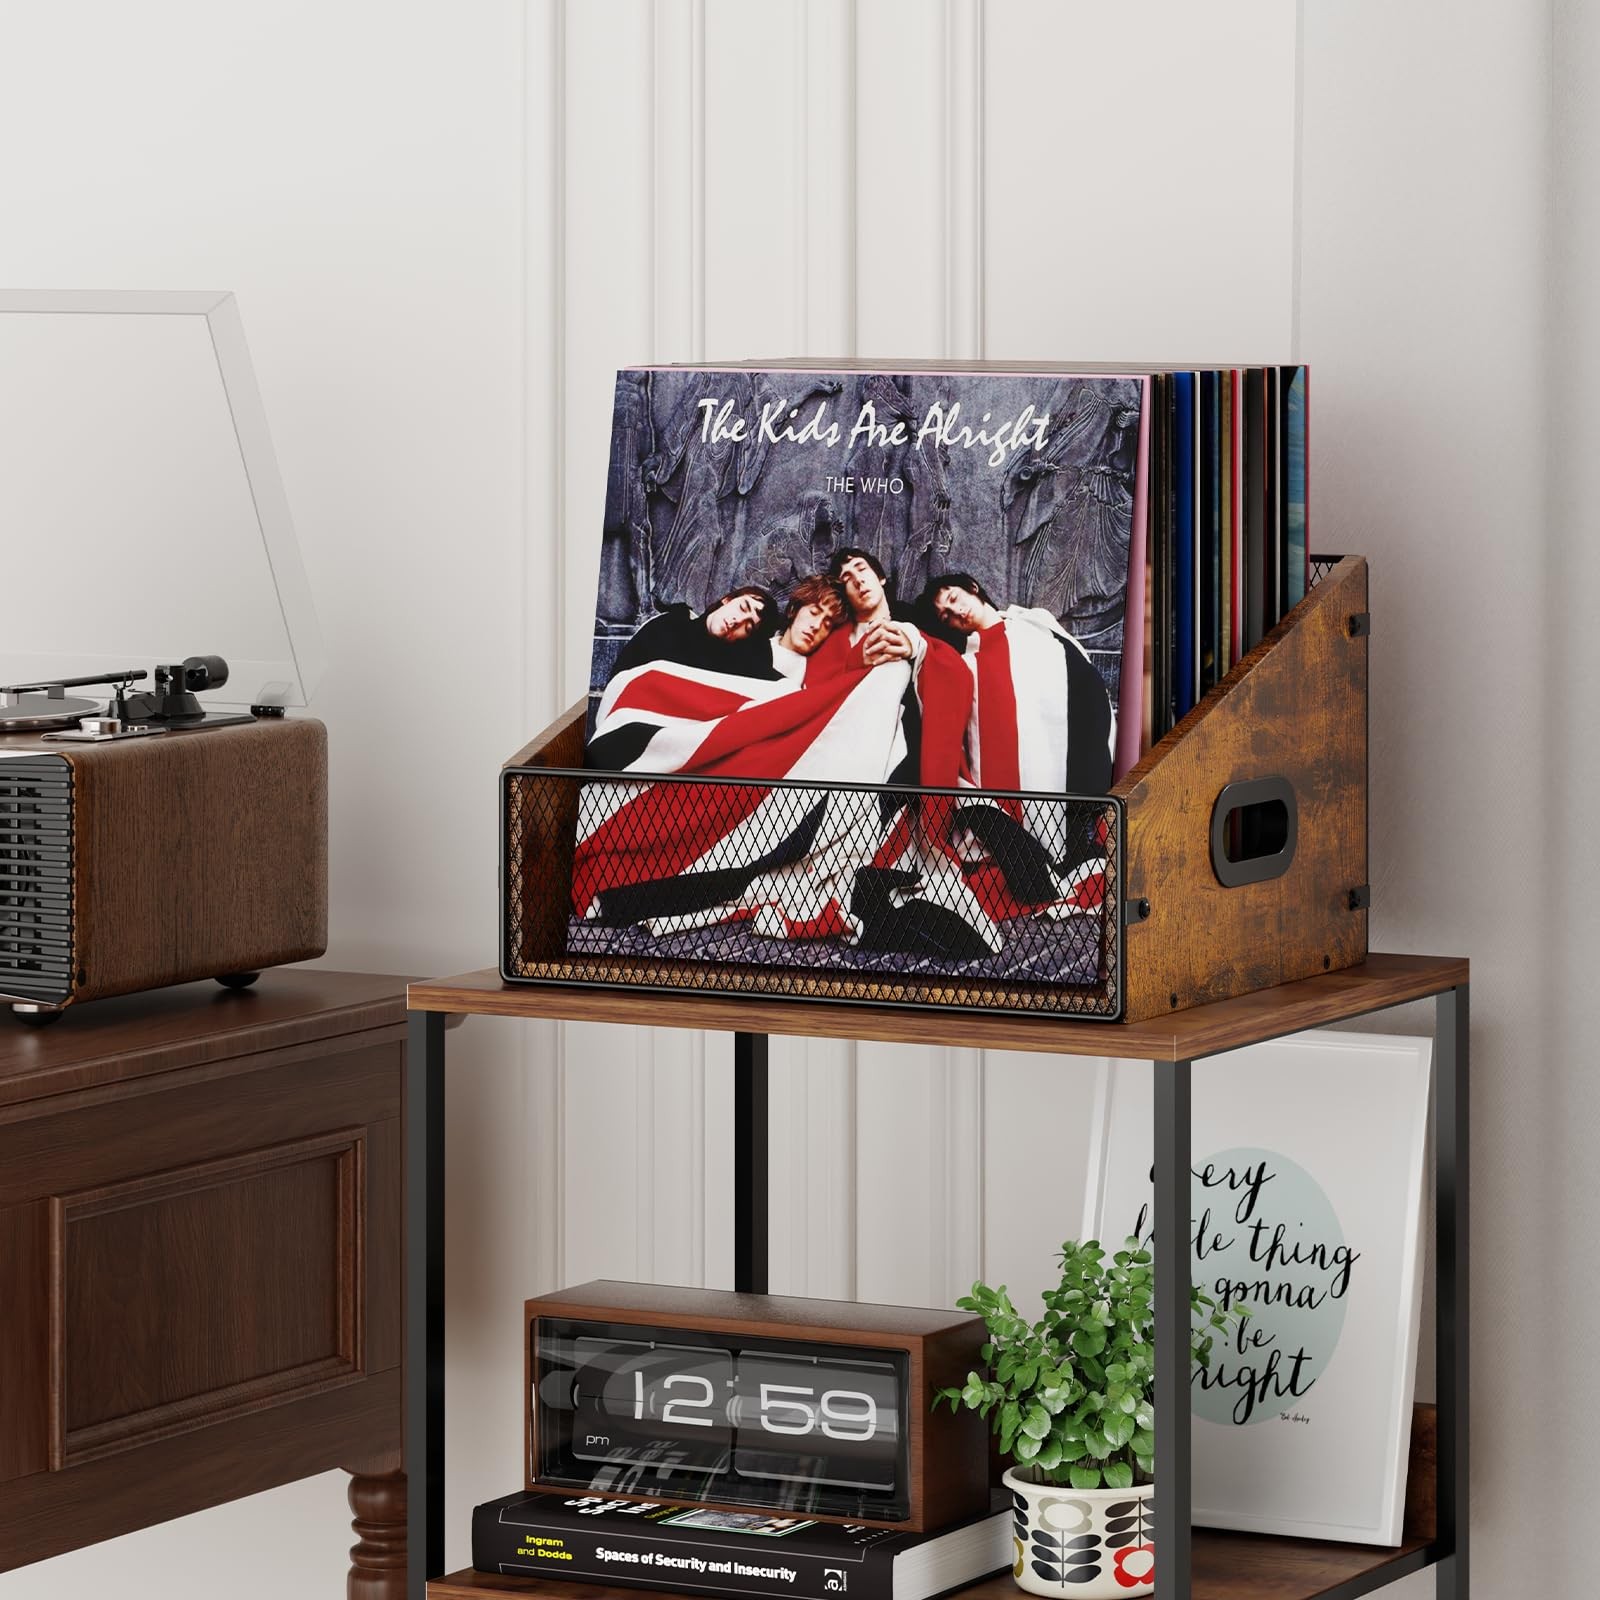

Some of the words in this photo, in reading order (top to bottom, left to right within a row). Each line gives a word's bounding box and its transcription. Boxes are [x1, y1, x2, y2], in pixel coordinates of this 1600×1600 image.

[697, 398, 749, 444] The
[756, 399, 841, 448] Kids
[847, 399, 908, 449] Are
[915, 400, 1051, 468] Alright
[825, 476, 854, 493] THE
[860, 478, 904, 495] WHO
[1247, 1218, 1361, 1299] thing
[1214, 1277, 1328, 1312] gonna
[1236, 1316, 1276, 1355] be
[634, 1371, 714, 1427] 12
[760, 1383, 877, 1442] 59
[585, 1434, 610, 1447] pm
[517, 1548, 535, 1556] and
[537, 1549, 573, 1560] Dodds
[525, 1535, 564, 1547] Ingram
[595, 1546, 639, 1563] Spaces
[640, 1553, 654, 1565] of
[655, 1553, 707, 1573] Security
[708, 1561, 732, 1574] and
[733, 1562, 797, 1583] Insecurity
